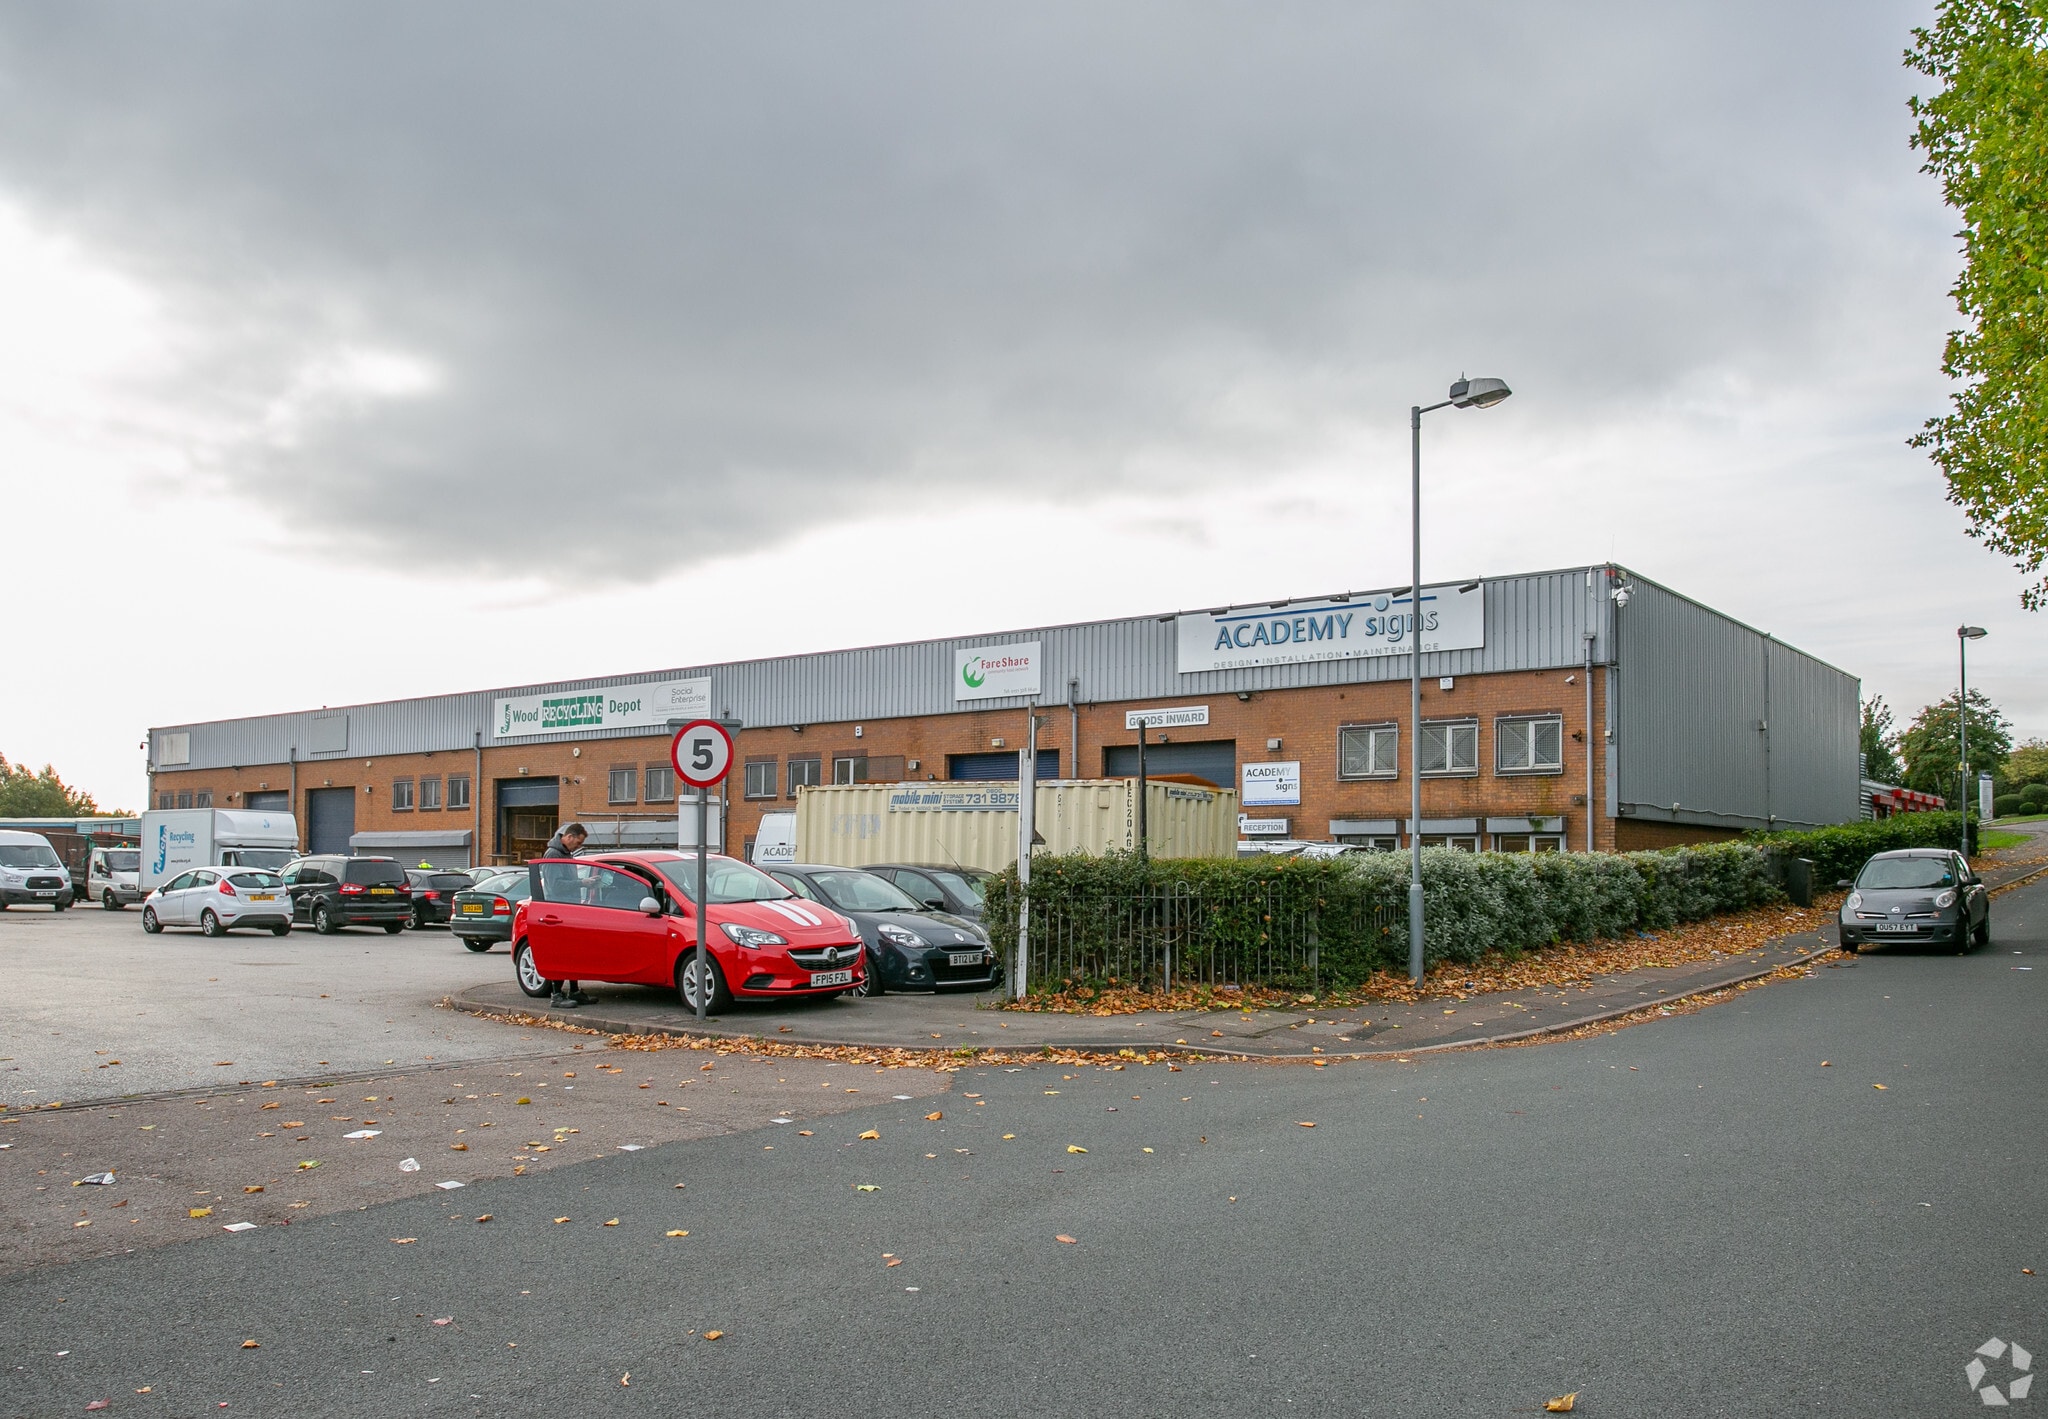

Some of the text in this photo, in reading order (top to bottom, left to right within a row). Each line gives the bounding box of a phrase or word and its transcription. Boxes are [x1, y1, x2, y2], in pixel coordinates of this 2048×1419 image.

[1214, 610, 1439, 650] ACADEMY signs
[1214, 642, 1439, 669] DESIGN INSTALLATION MAINTENACE
[981, 656, 1029, 669] FareShare
[671, 686, 693, 696] Social
[671, 694, 706, 704] Enterprise
[513, 708, 539, 722] Wood
[542, 702, 603, 722] RECYCLING
[609, 698, 642, 716] Depot
[1129, 712, 1205, 727] GOODS INWARD
[691, 738, 713, 770] 5
[1246, 767, 1291, 777] ACADEMY
[1275, 782, 1298, 792] signs
[891, 790, 943, 804] mobile mini
[966, 793, 987, 804] 731
[1243, 823, 1284, 832] RECEPTION
[169, 831, 195, 843] Recycling
[953, 955, 967, 964] BT12
[815, 972, 849, 985] FP15 FZL
